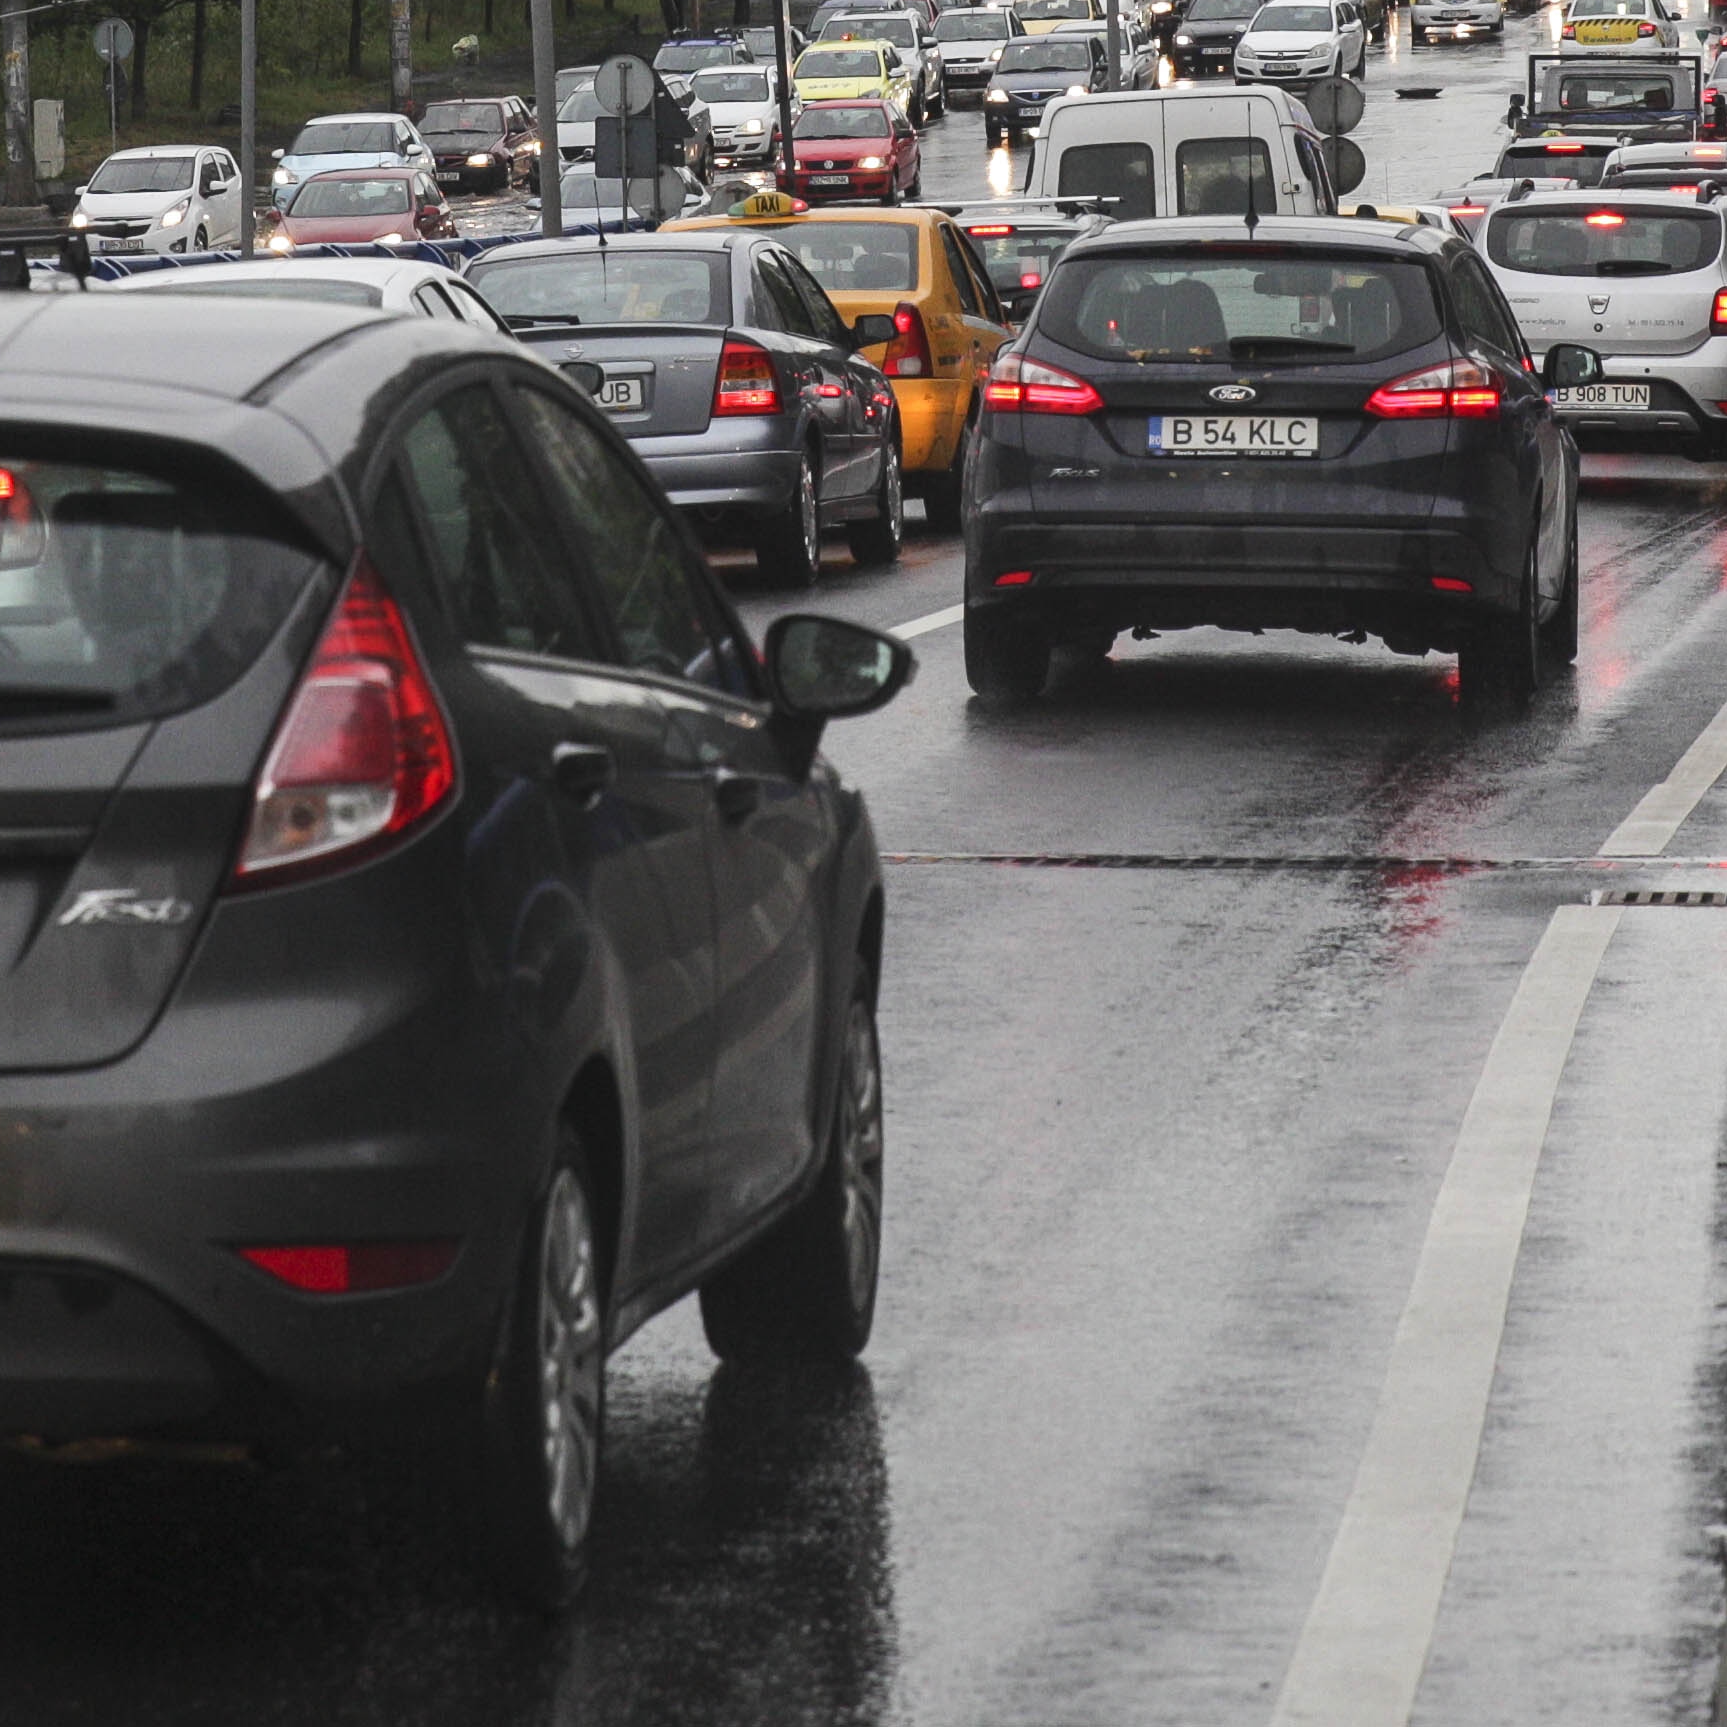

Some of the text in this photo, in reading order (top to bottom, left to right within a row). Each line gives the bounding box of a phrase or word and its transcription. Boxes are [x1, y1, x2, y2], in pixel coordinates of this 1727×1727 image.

[754, 195, 780, 213] TAXI
[593, 382, 631, 404] UB
[1557, 387, 1648, 403] B 908 TUN
[1173, 420, 1192, 445] B
[1204, 420, 1236, 445] 54
[1249, 420, 1307, 445] KLC
